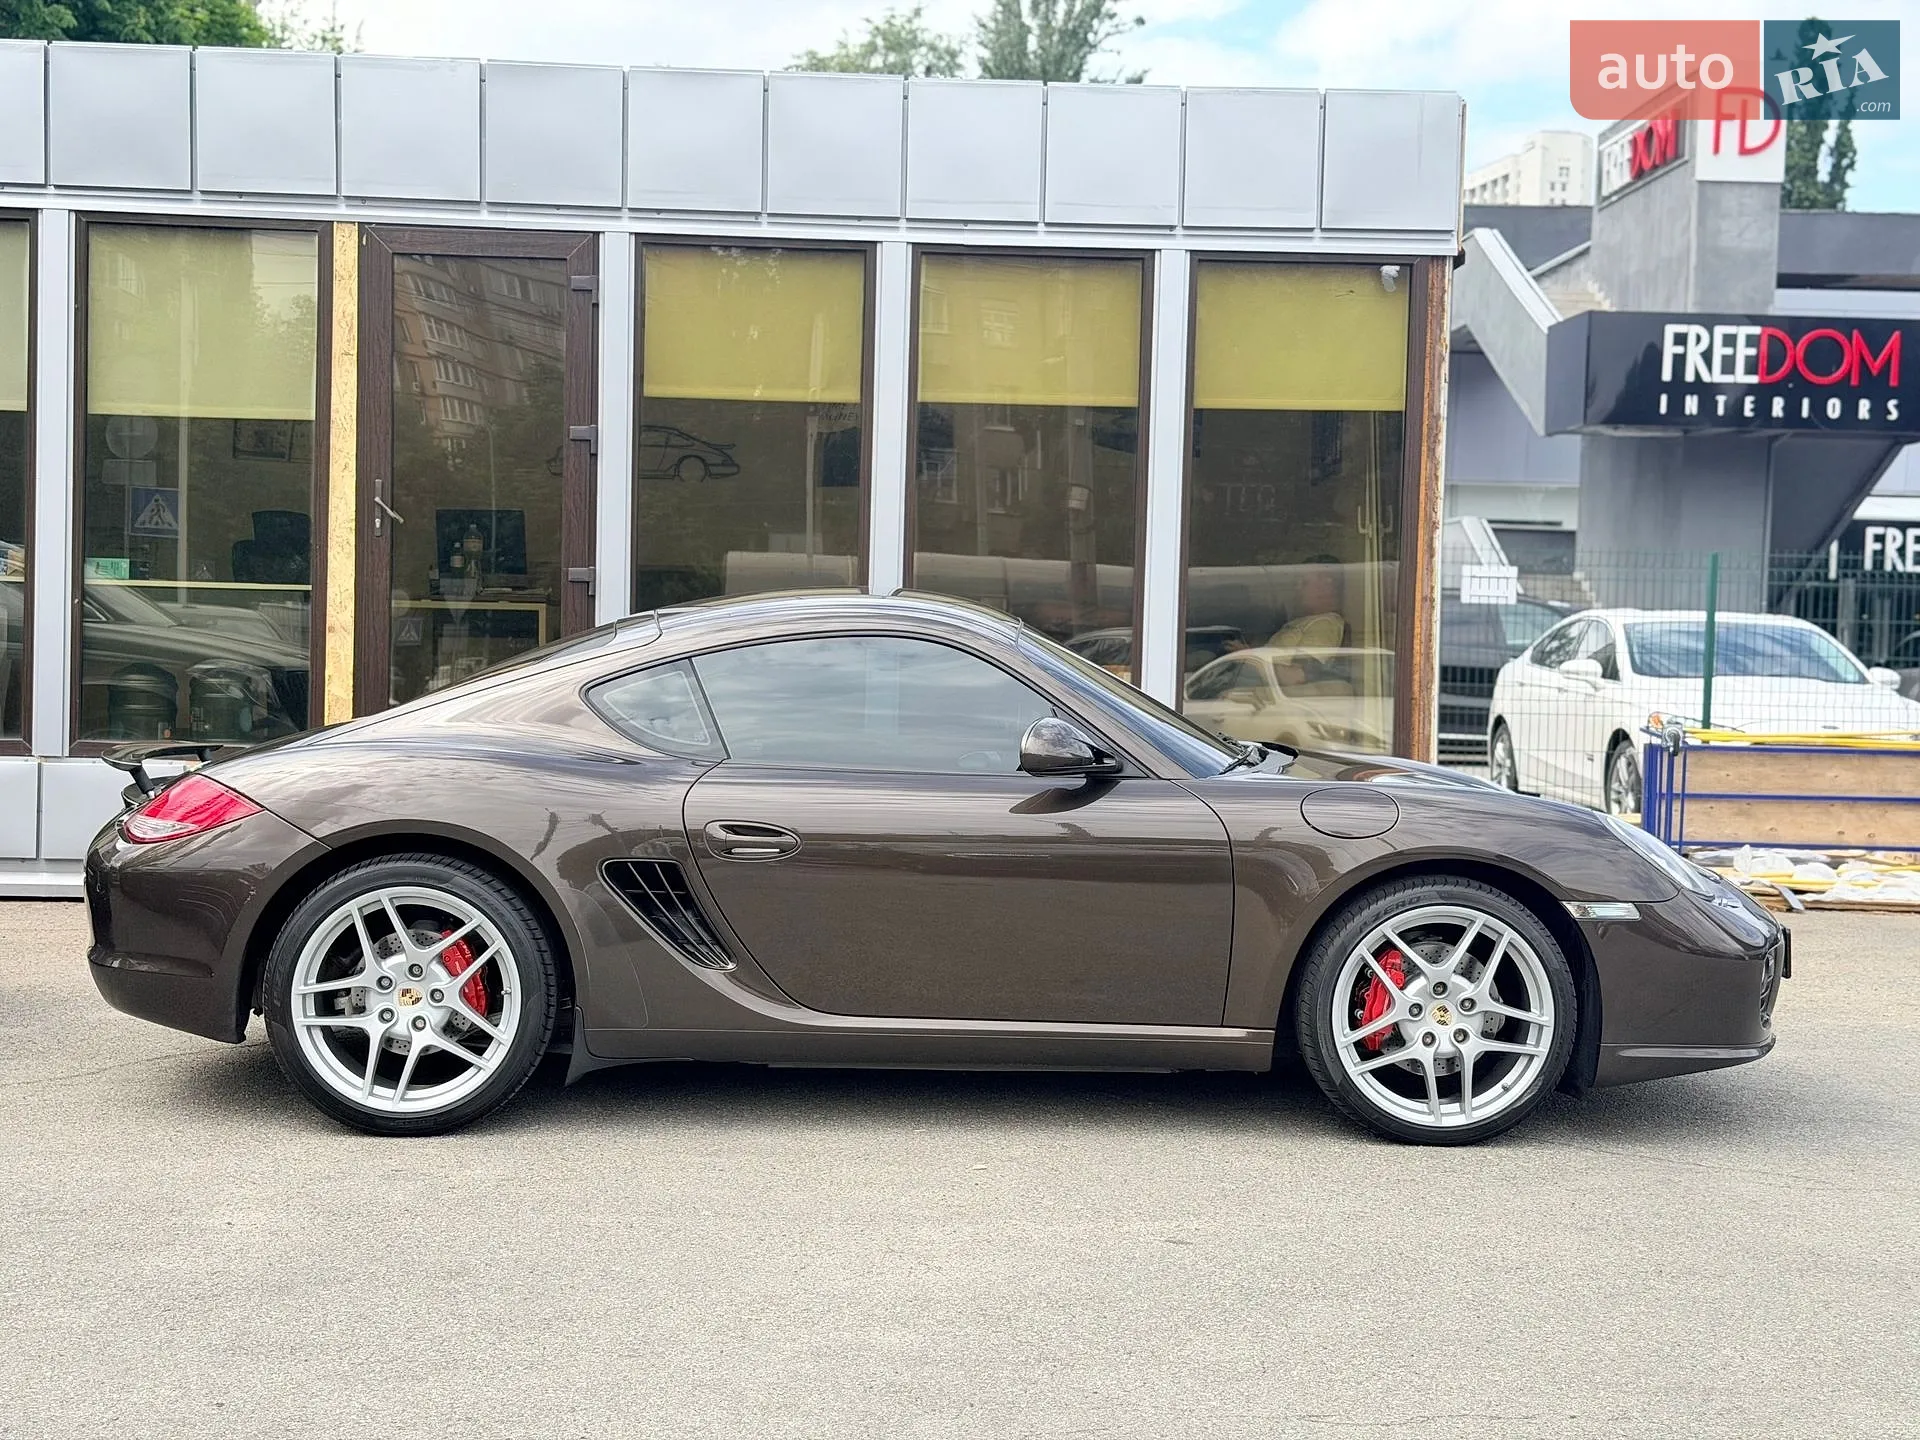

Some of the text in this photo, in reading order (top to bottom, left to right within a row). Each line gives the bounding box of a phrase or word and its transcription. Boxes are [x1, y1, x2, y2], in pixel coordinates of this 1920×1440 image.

[1713, 86, 1782, 156] FD
[1661, 323, 1902, 387] FREEDOM
[1659, 393, 1900, 420] INTERIORS
